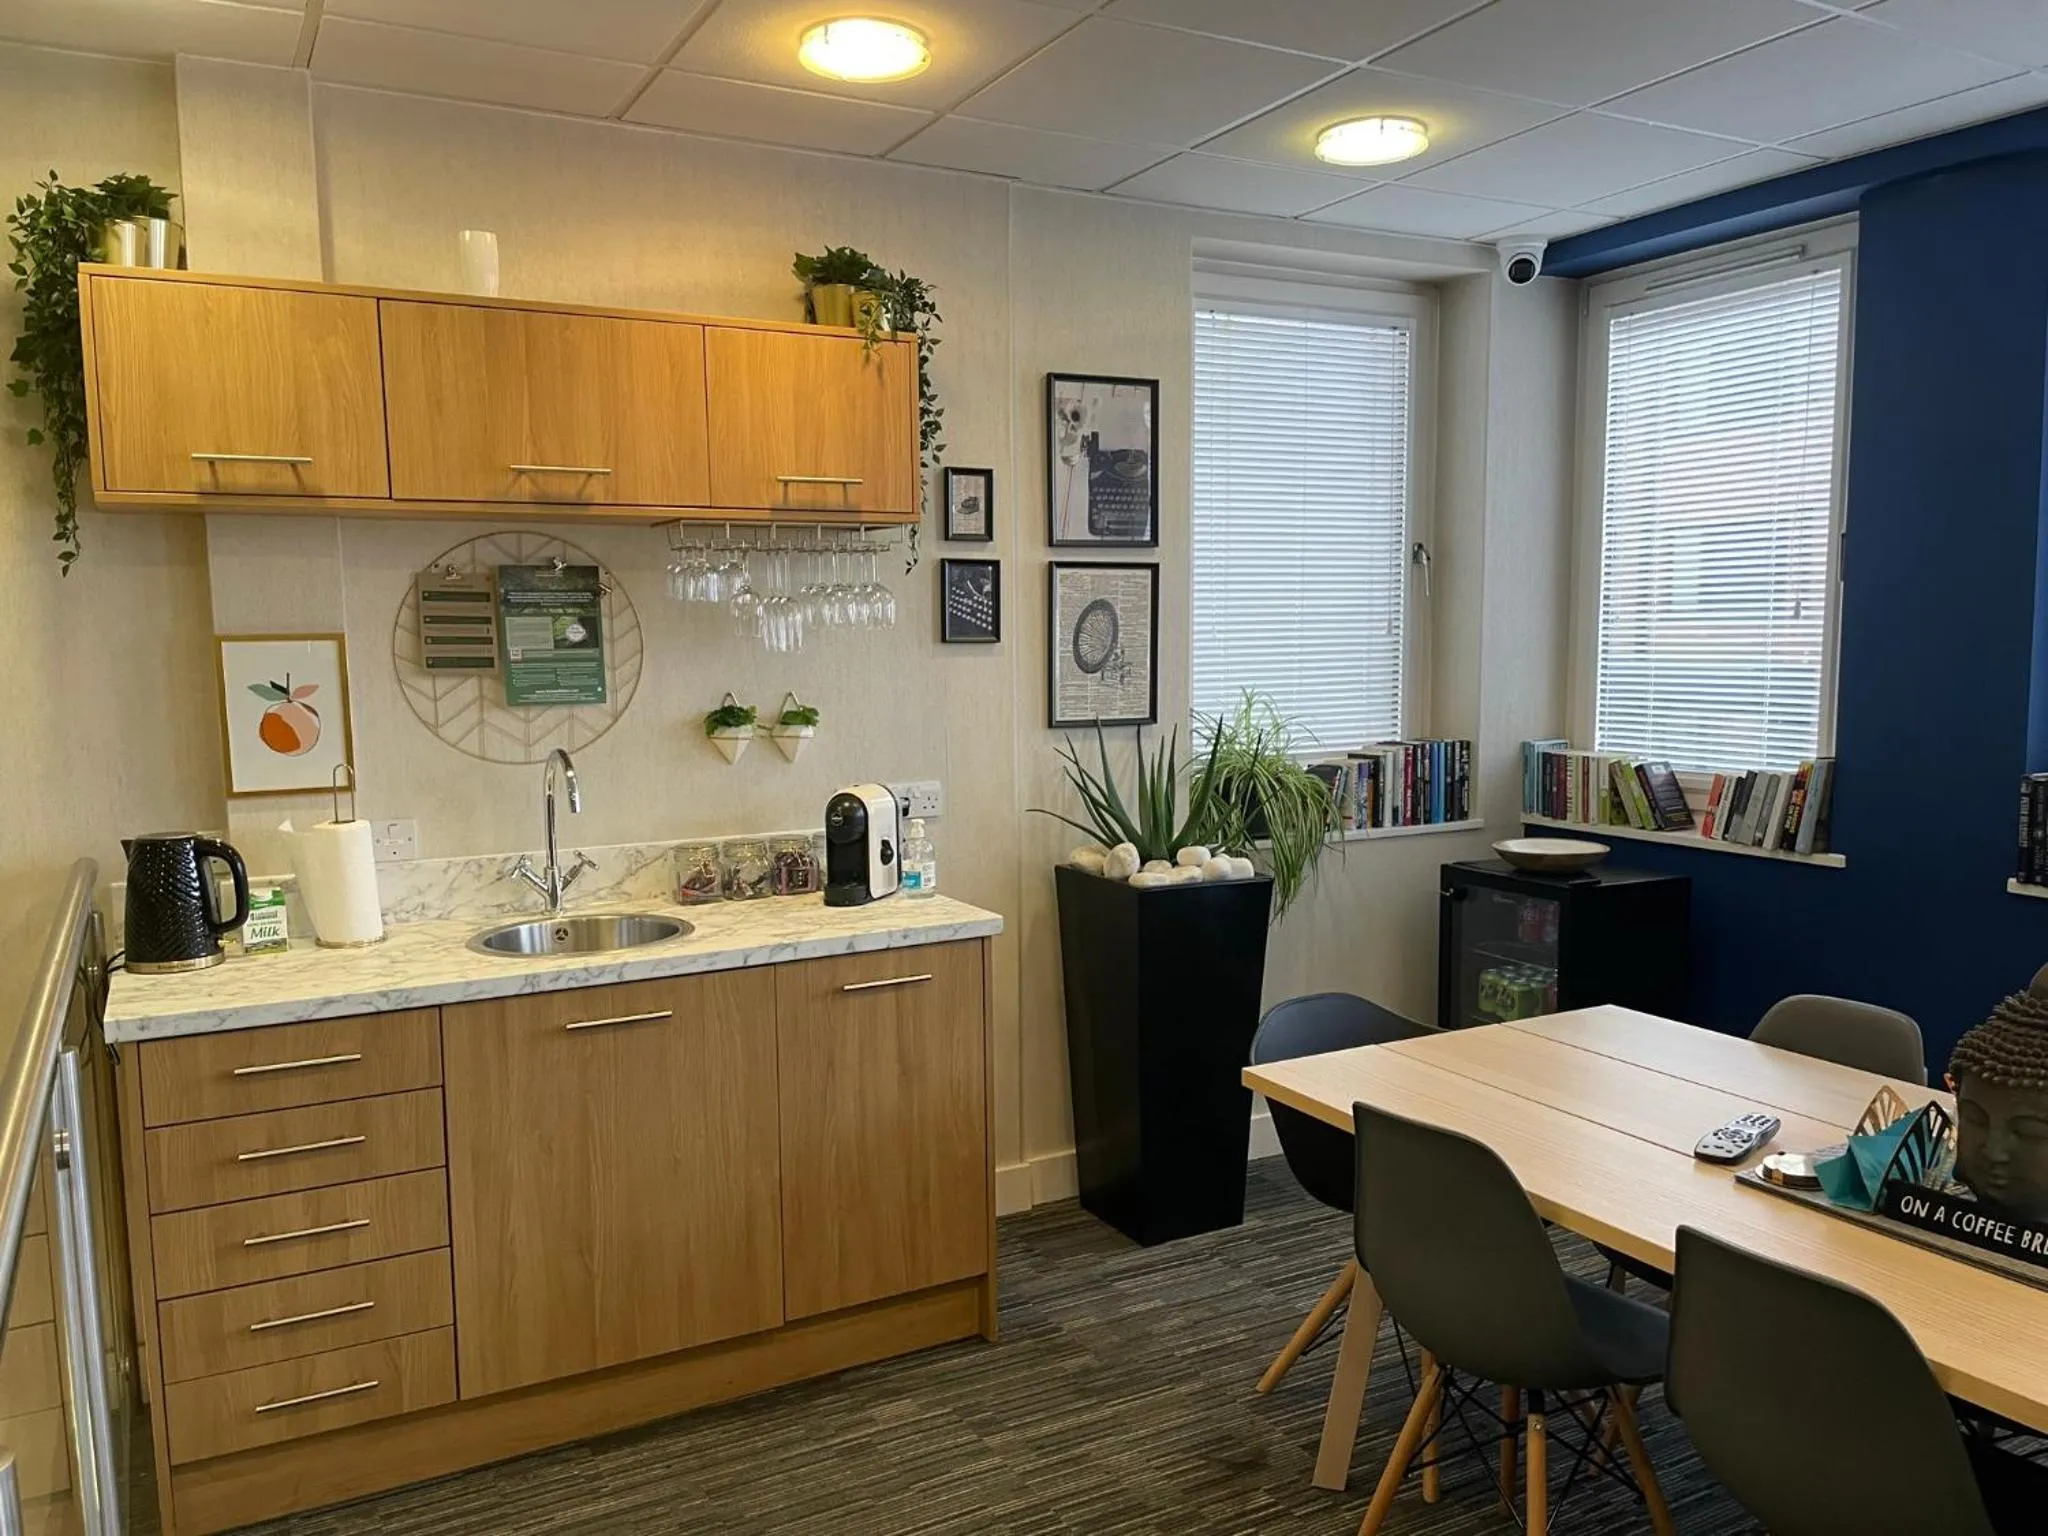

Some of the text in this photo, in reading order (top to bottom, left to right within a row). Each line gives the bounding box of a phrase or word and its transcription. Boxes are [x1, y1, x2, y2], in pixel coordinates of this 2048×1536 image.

[250, 926, 280, 939] Milk
[1900, 1195, 1930, 1217] ON
[1933, 1206, 1945, 1222] A
[1952, 1211, 2016, 1244] COFFEE
